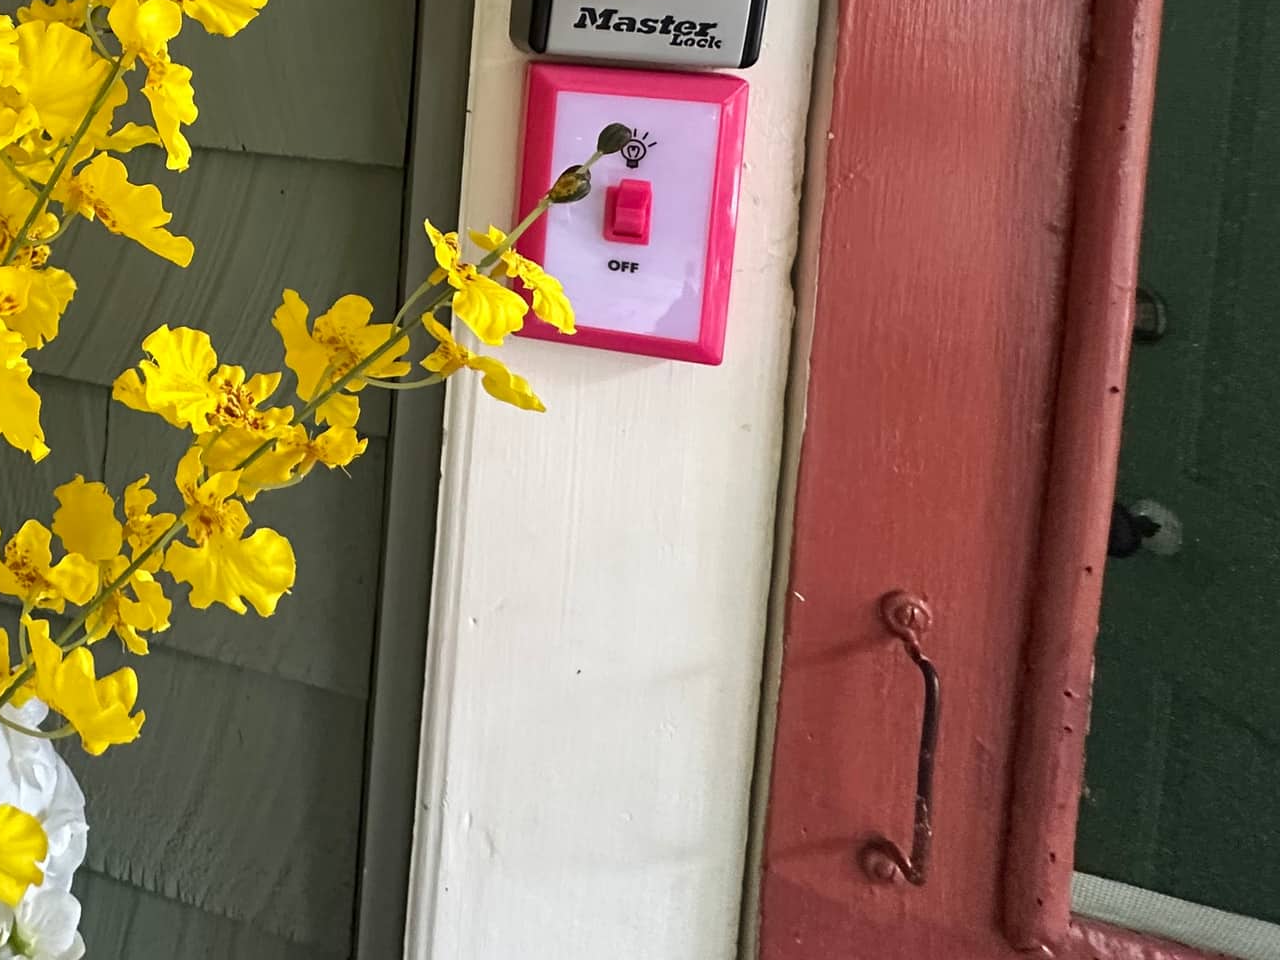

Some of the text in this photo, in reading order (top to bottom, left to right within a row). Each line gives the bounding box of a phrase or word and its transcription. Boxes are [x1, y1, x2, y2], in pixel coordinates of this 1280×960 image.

[573, 7, 718, 38] Master
[669, 33, 722, 49] Lock
[607, 259, 639, 273] OFF
